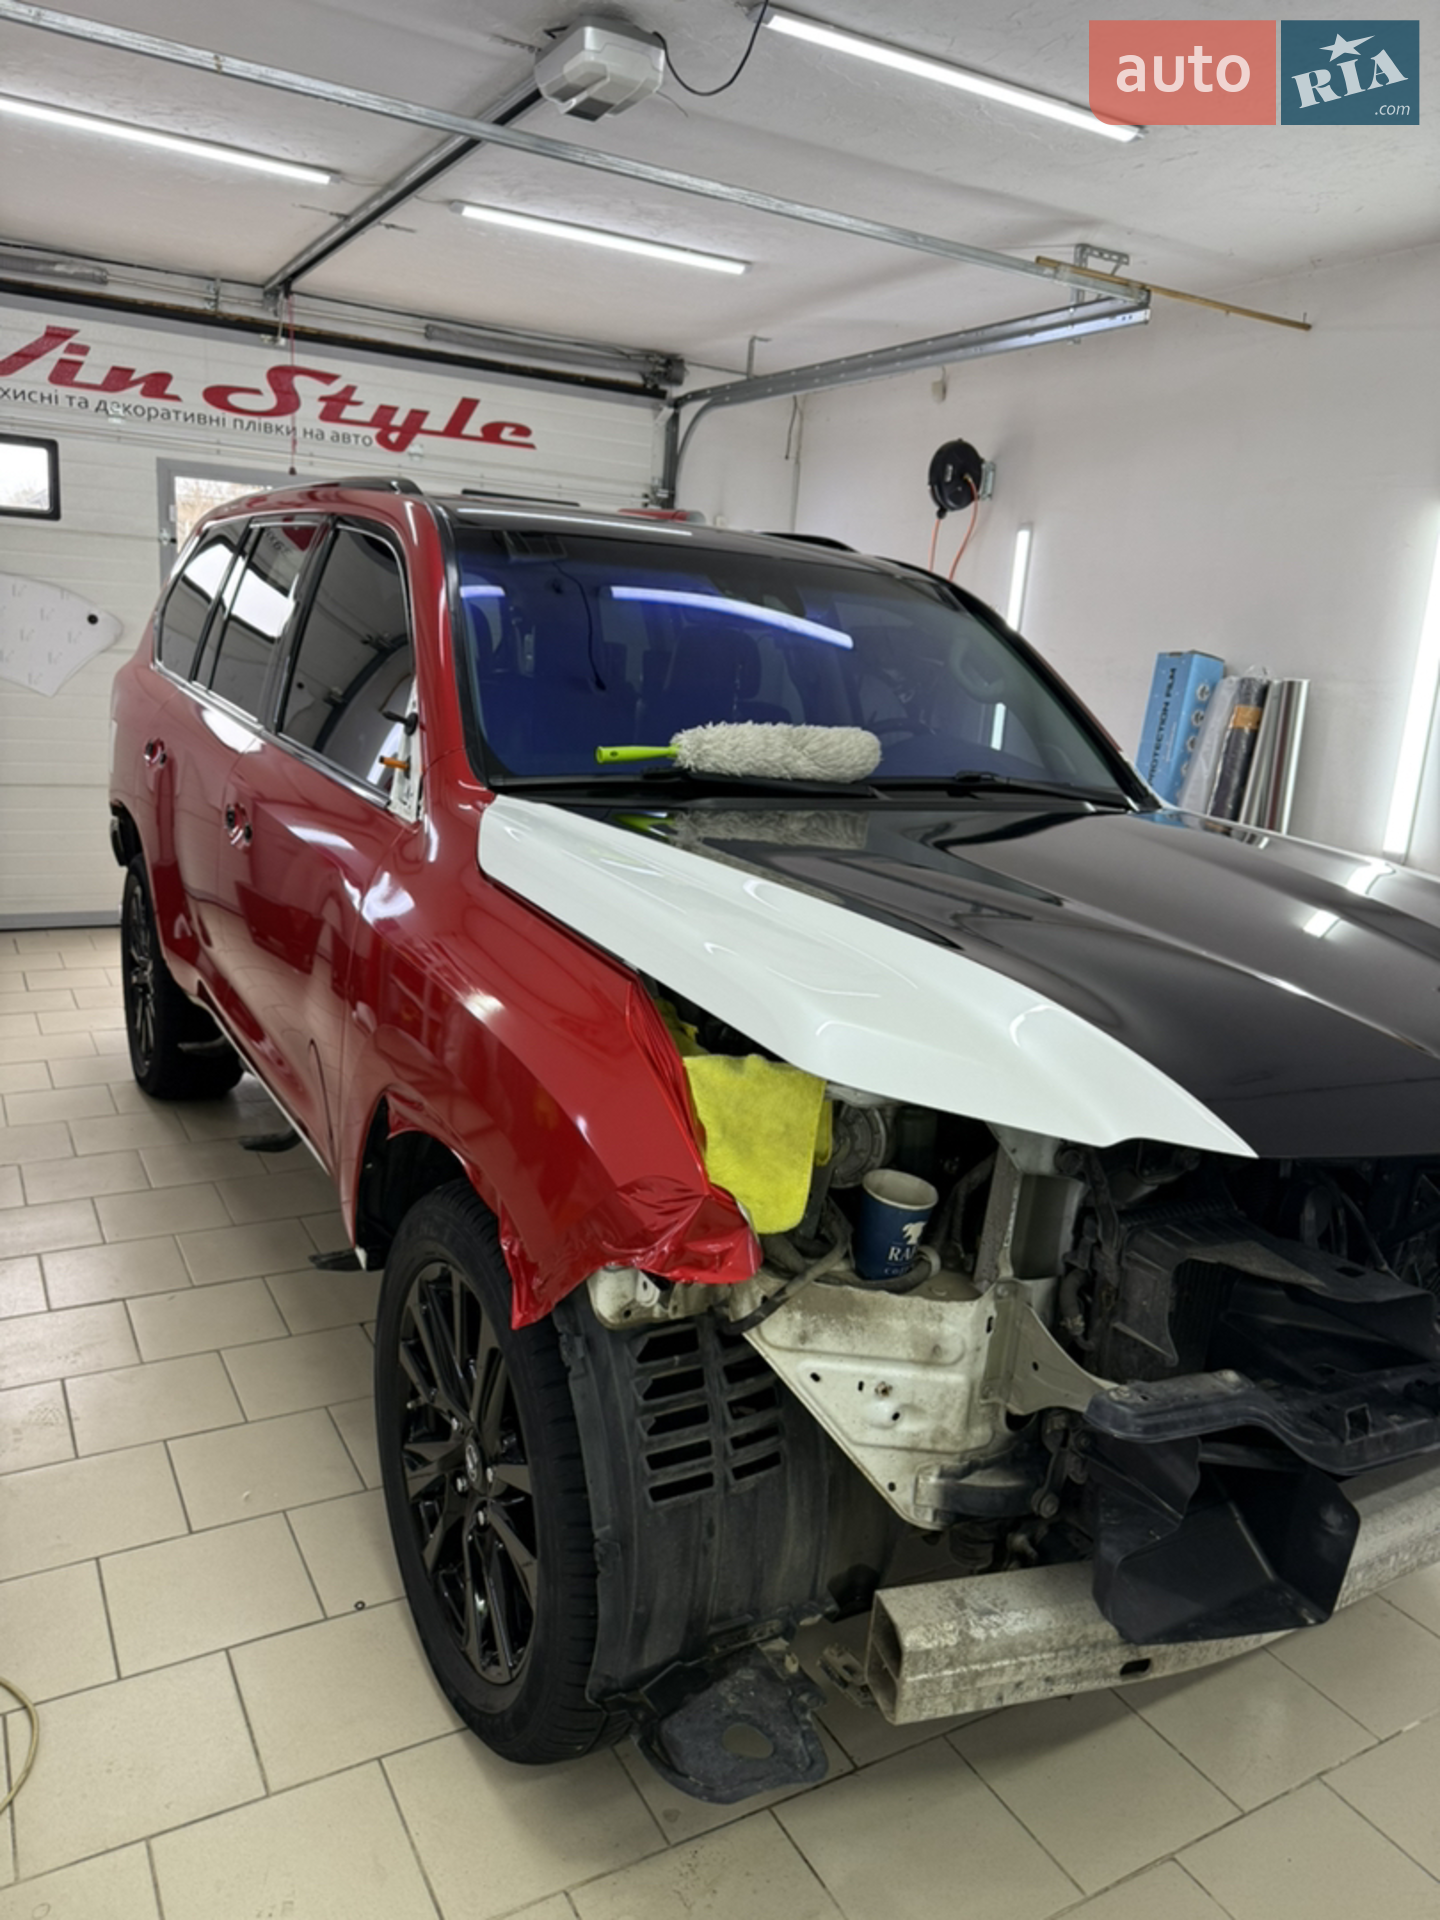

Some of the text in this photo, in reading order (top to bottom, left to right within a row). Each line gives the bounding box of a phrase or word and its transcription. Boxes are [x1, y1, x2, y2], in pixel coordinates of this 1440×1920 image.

[65, 393, 90, 410] та
[233, 417, 298, 437] плівки
[303, 427, 325, 441] на
[331, 431, 373, 447] авто
[202, 364, 537, 453] Style
